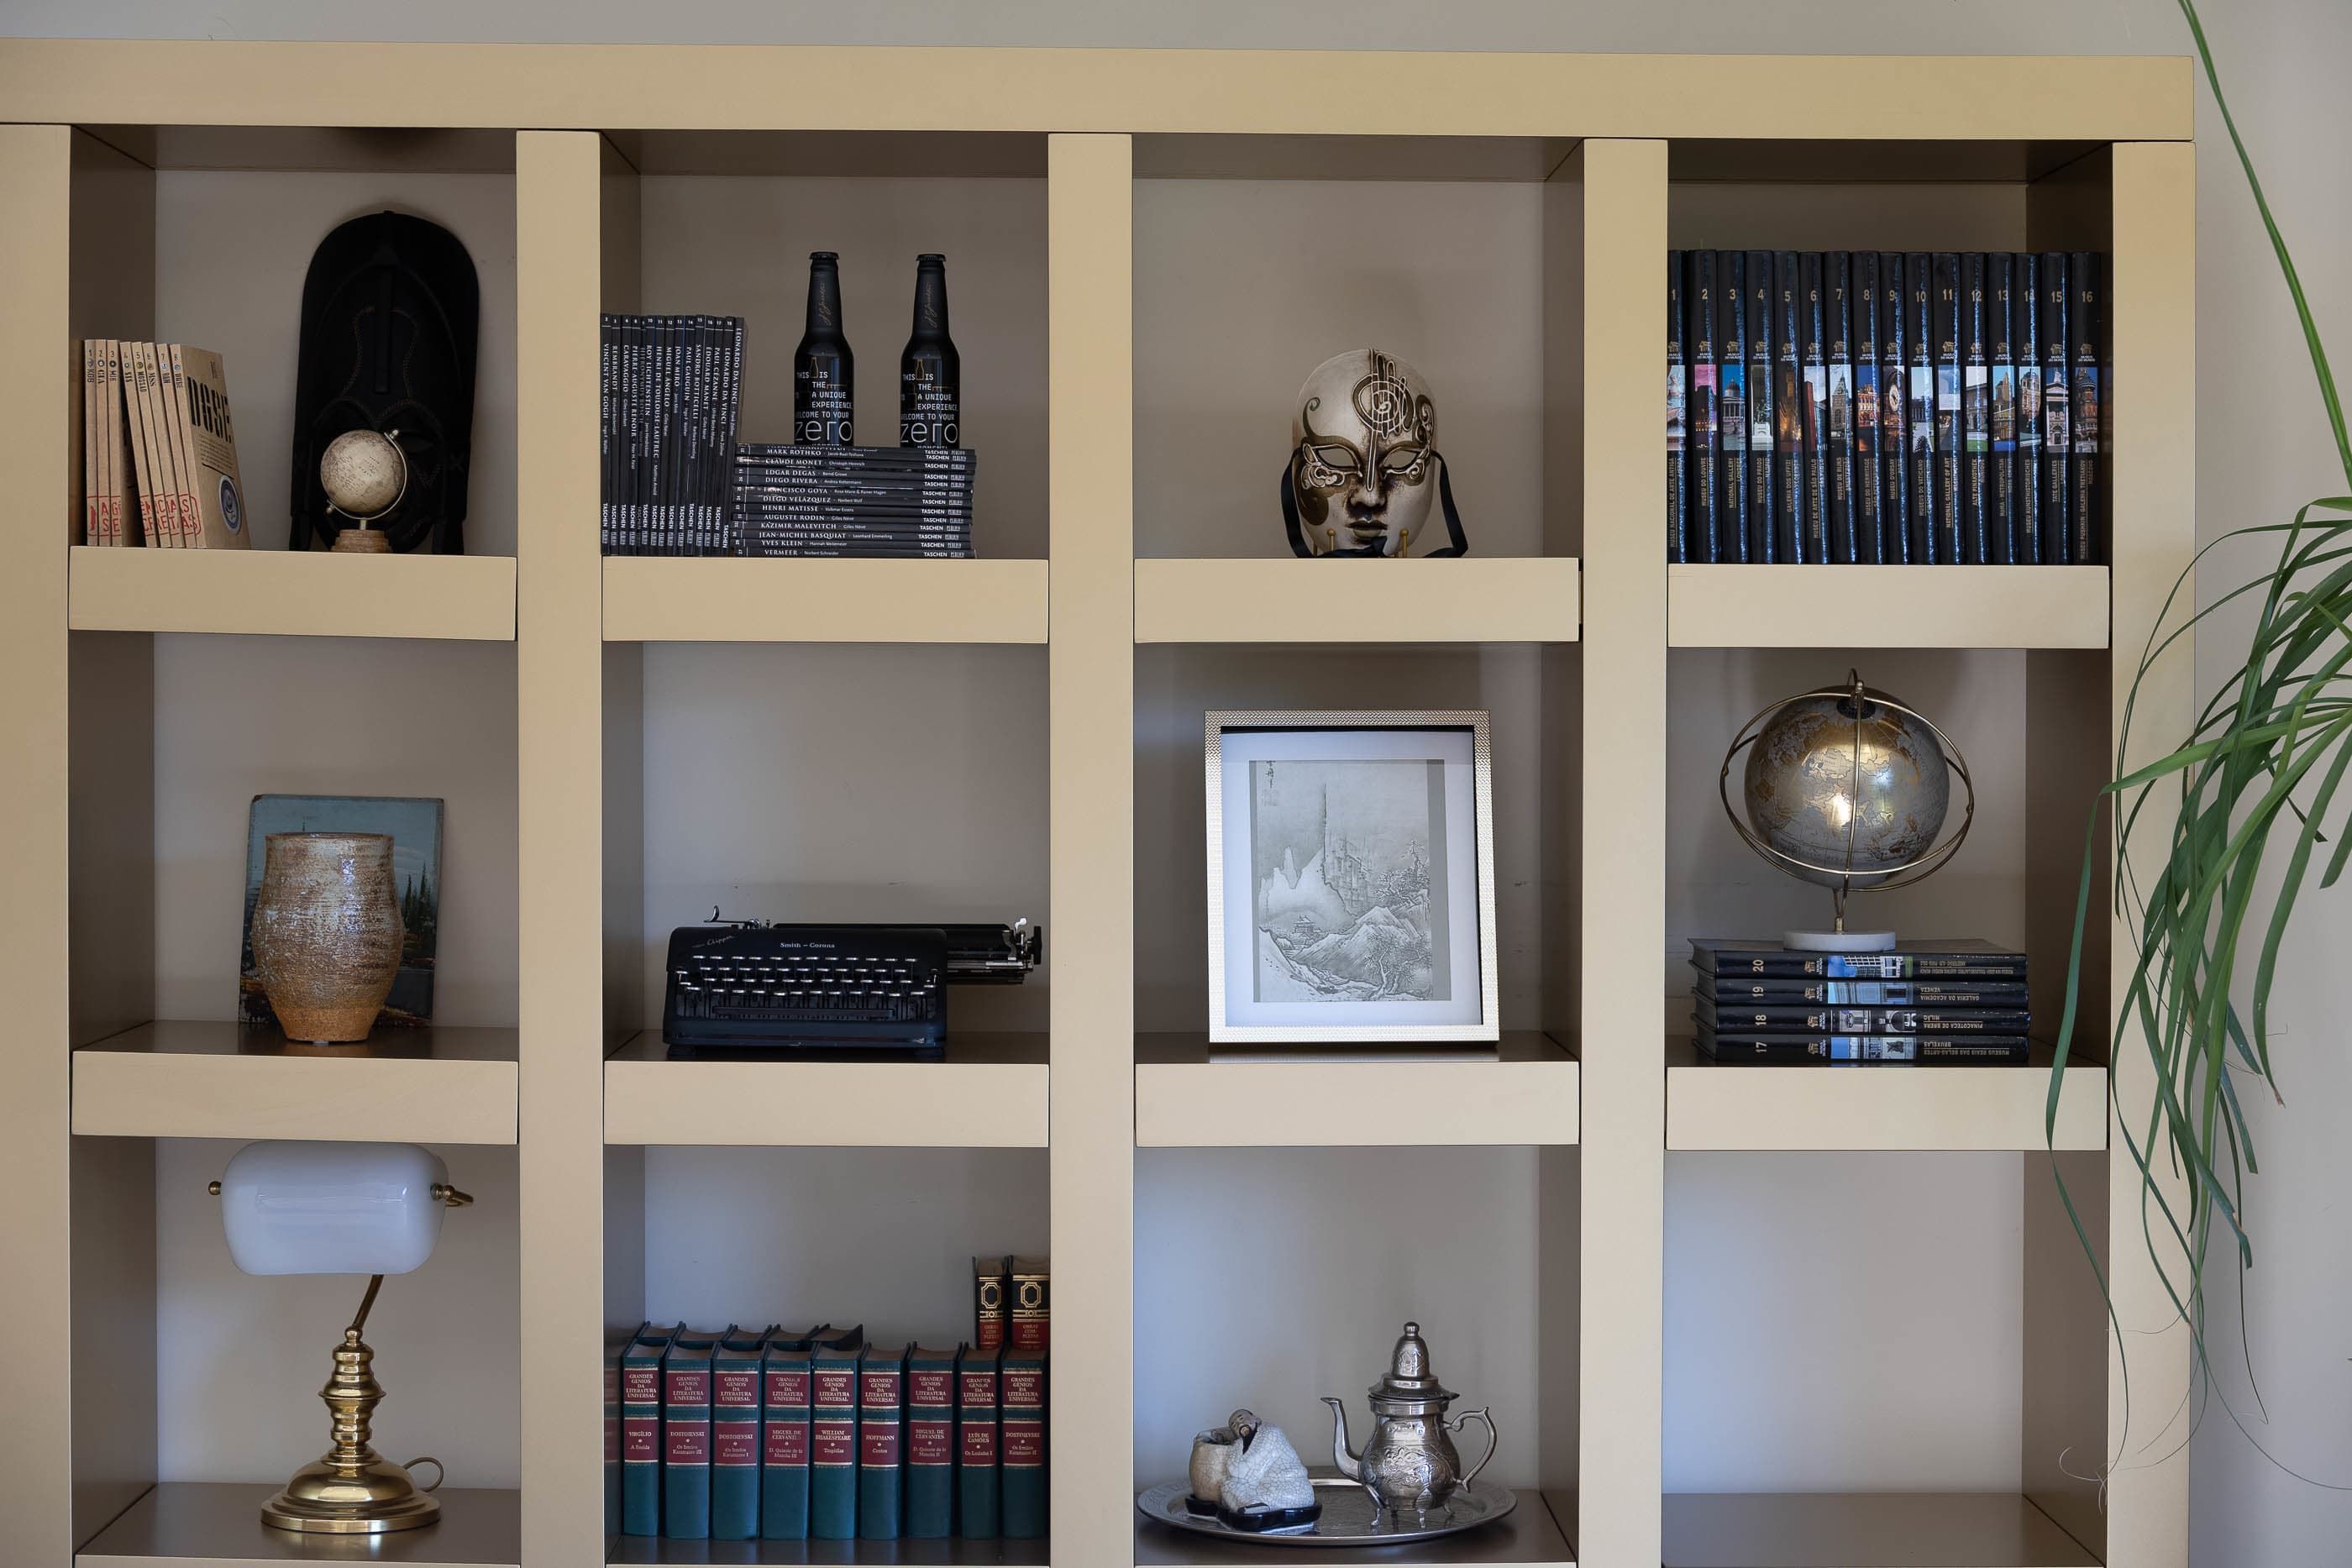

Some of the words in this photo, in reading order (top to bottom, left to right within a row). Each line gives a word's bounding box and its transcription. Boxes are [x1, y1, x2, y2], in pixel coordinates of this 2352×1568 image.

[1701, 289, 1709, 300] 2
[1730, 290, 1736, 300] 3
[1757, 290, 1765, 300] 4
[1784, 291, 1791, 302] 5
[1810, 291, 1817, 302] 6
[1835, 289, 1841, 300] 7
[1863, 290, 1870, 301] 8
[1889, 291, 1895, 302] 9
[1916, 291, 1927, 302] 10
[1943, 289, 1953, 301] 11
[1971, 290, 1982, 302] 12
[1997, 290, 2008, 302] 13
[2050, 291, 2062, 302] 15
[2082, 291, 2093, 302] 16
[655, 372, 661, 382] DE
[732, 370, 738, 380] DA
[137, 371, 147, 392] MOSSAD
[722, 391, 728, 401] DA
[795, 422, 853, 441] zero
[900, 423, 958, 443] zero
[1751, 959, 1764, 972] 20
[1751, 986, 1764, 999] 19
[1755, 1015, 1767, 1027] 18
[1755, 1042, 1767, 1053] 17
